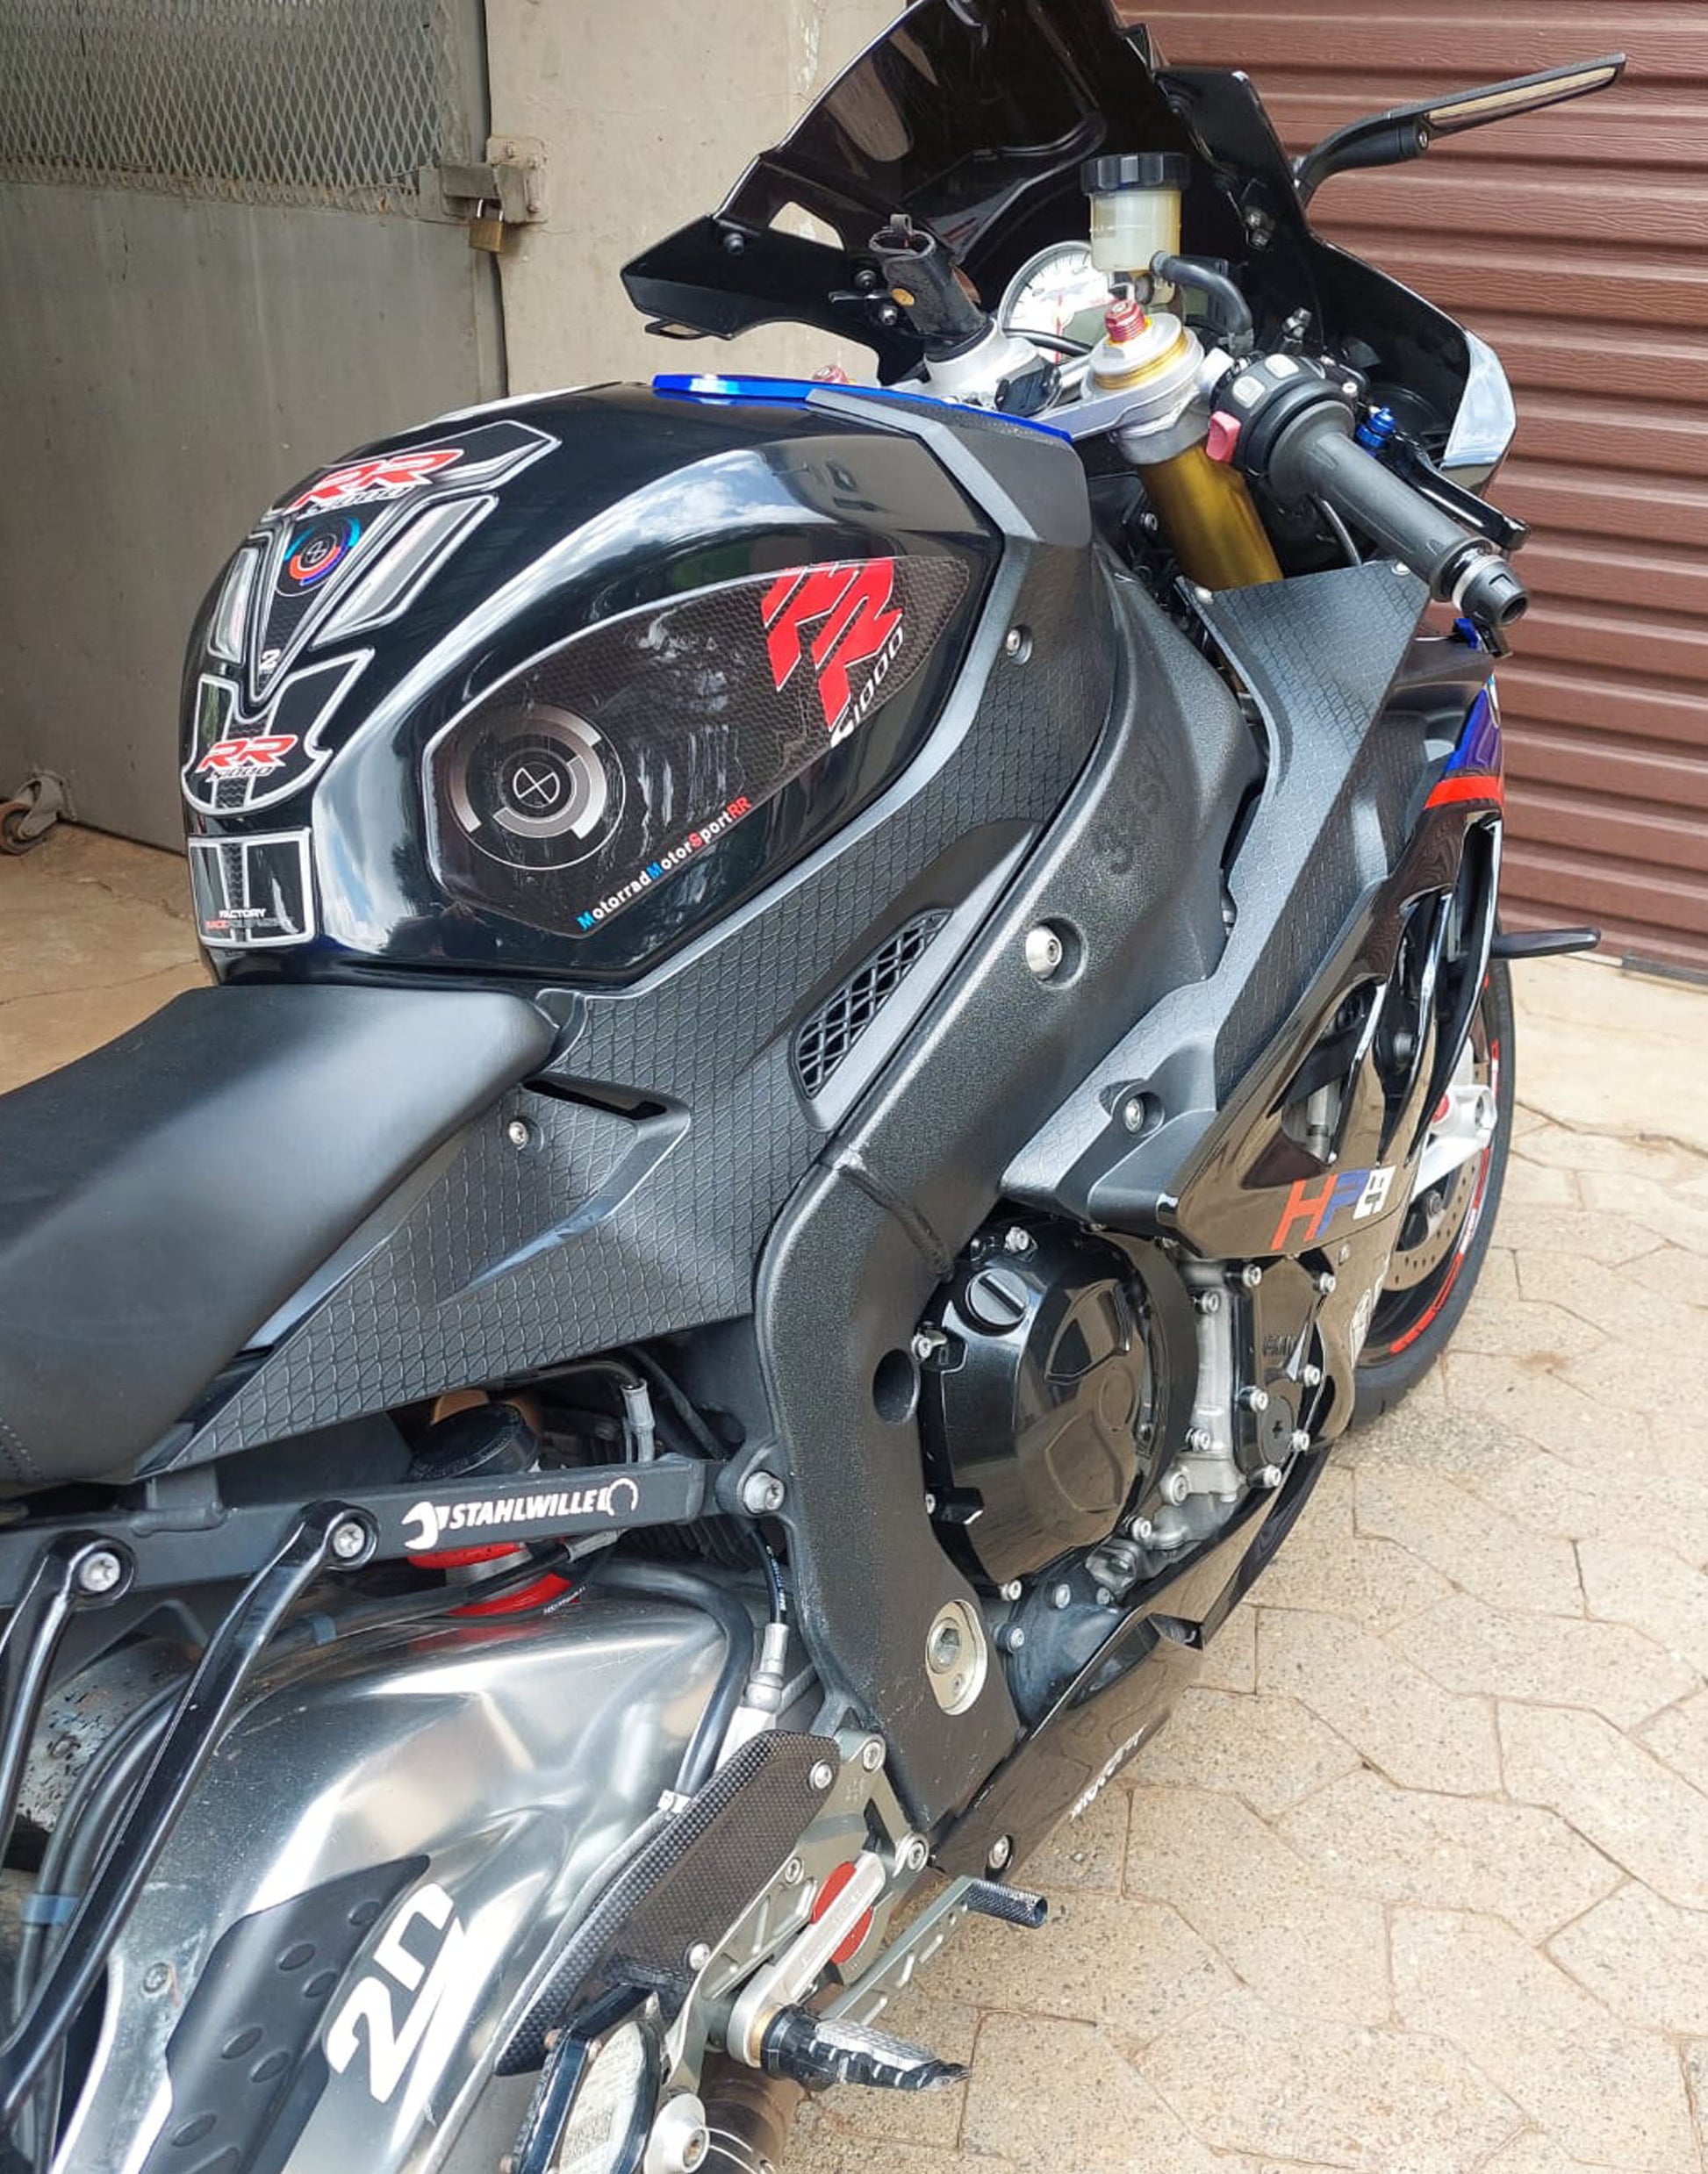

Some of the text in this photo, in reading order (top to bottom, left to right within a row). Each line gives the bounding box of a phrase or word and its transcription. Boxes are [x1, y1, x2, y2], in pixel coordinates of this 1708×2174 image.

[283, 448, 465, 515] RR
[195, 734, 298, 773] RR
[449, 1489, 597, 1530] STAHLWILLE
